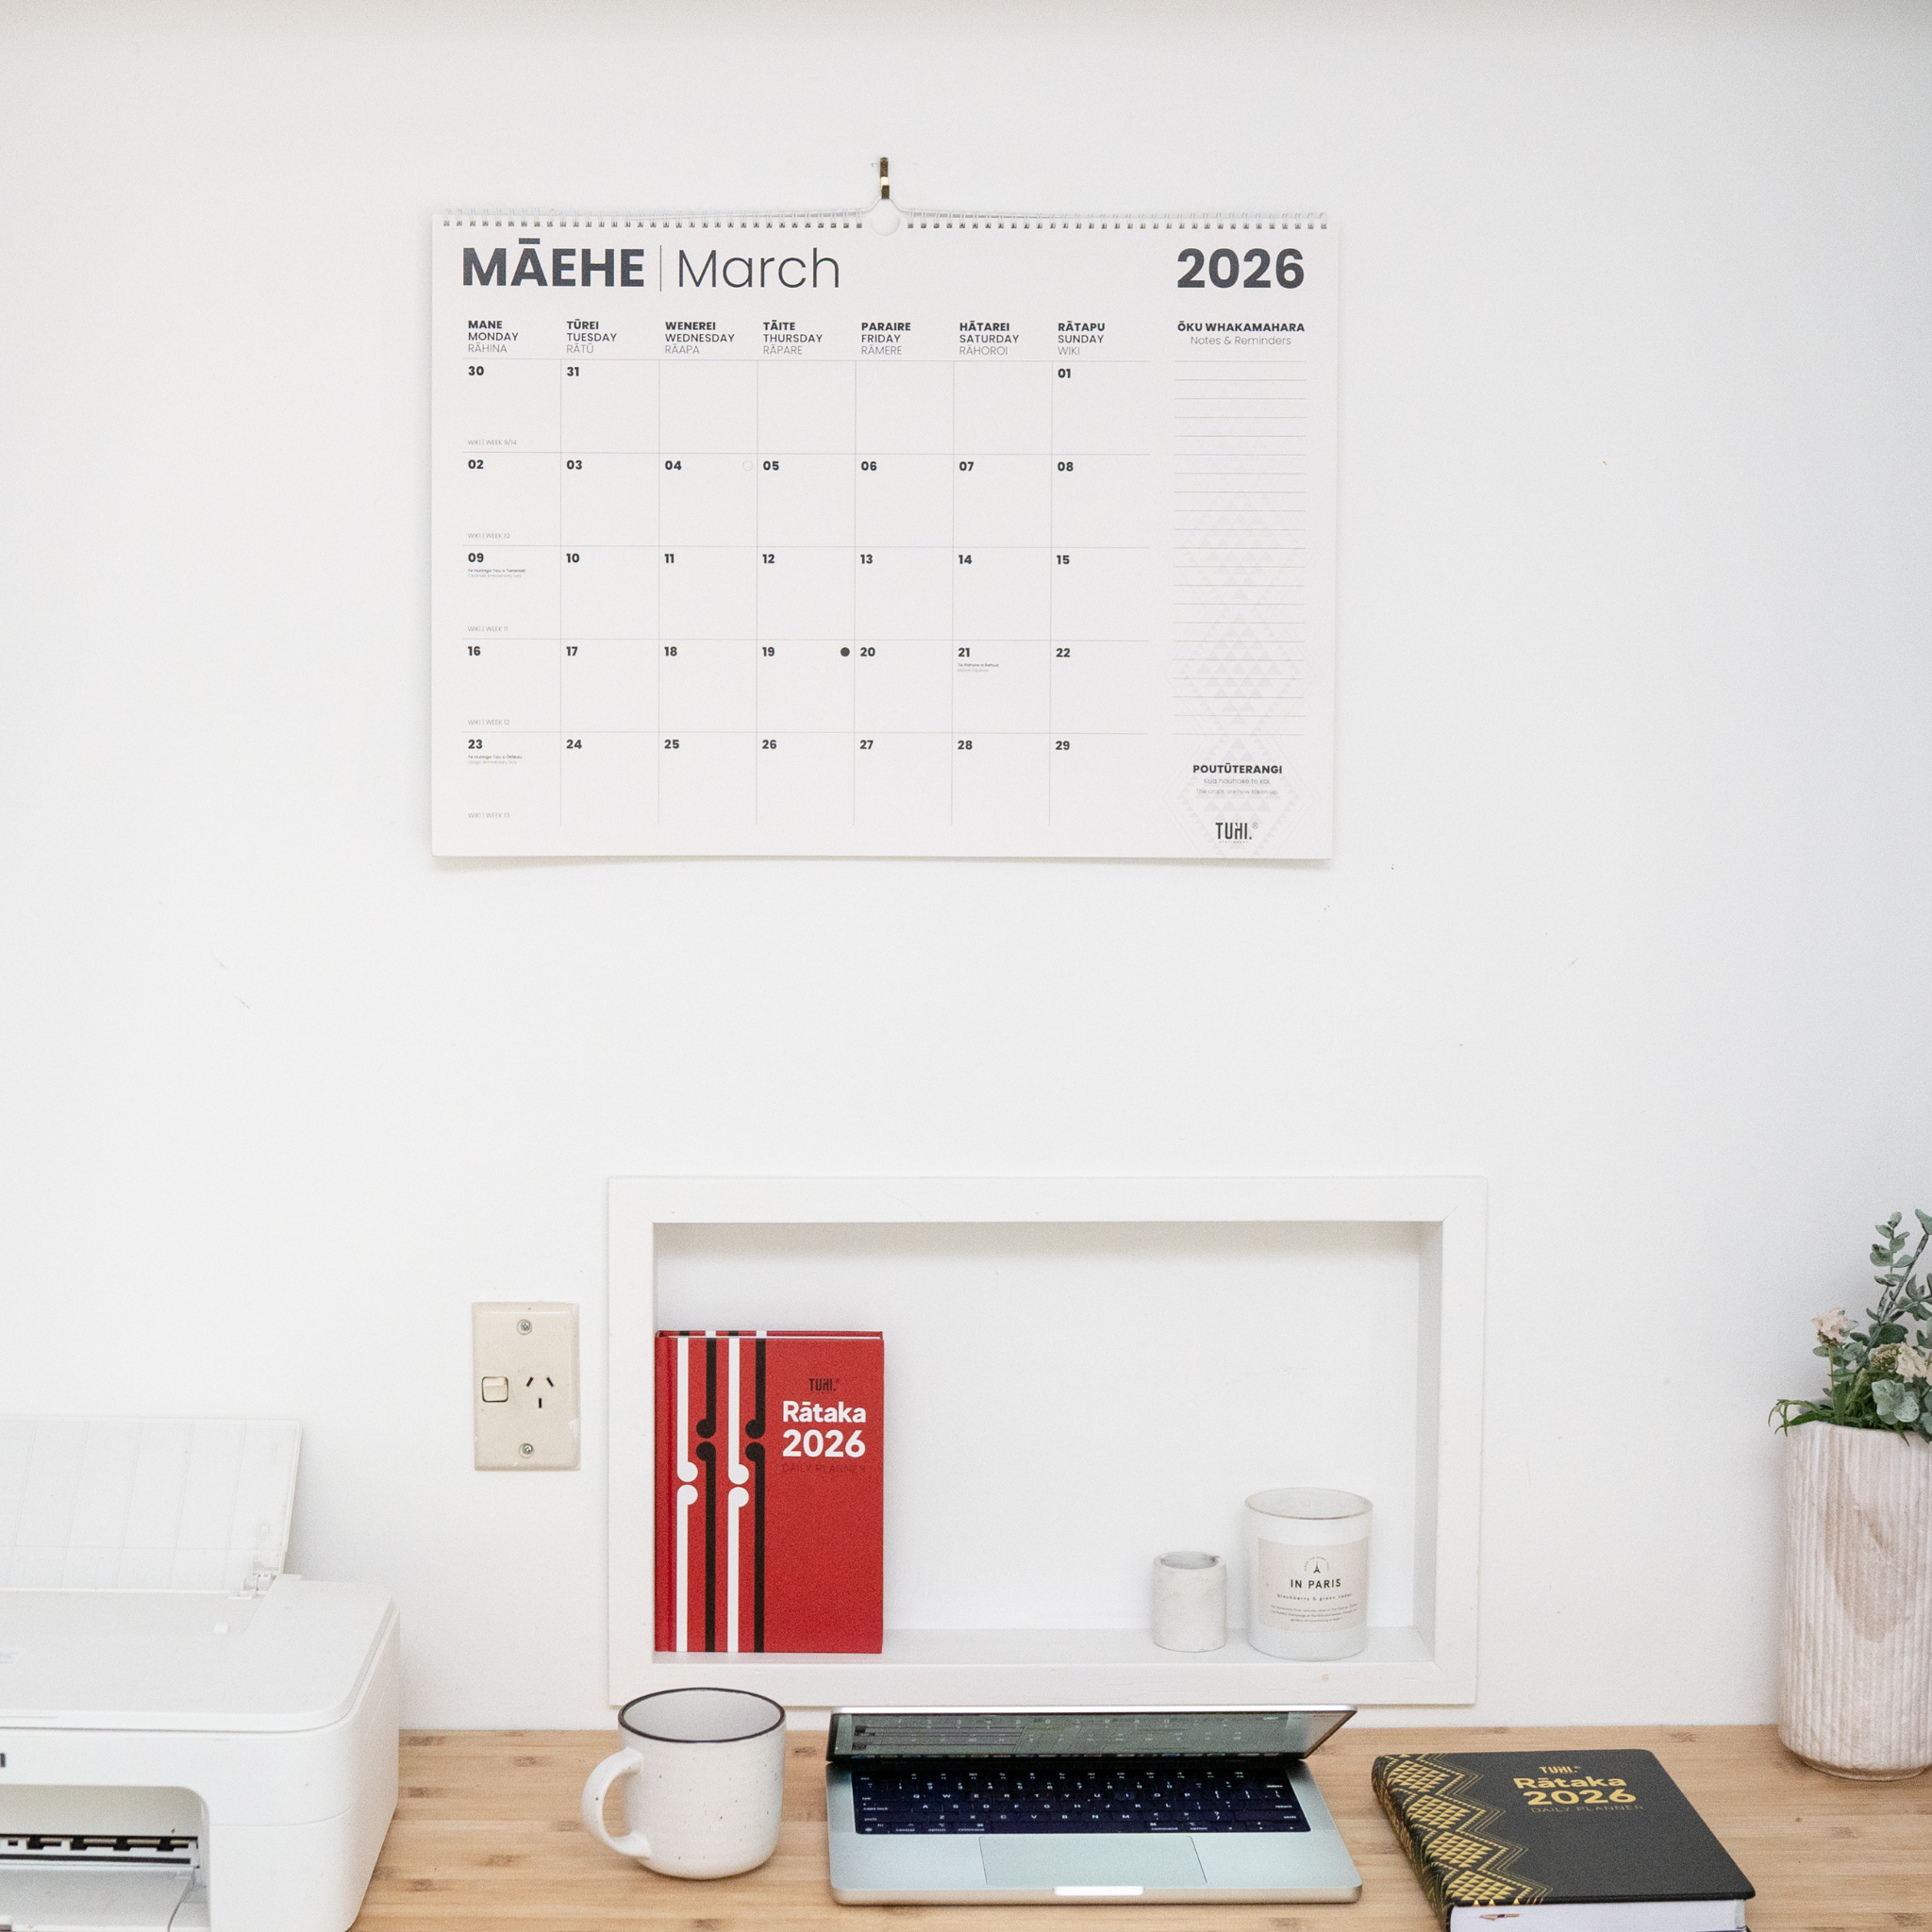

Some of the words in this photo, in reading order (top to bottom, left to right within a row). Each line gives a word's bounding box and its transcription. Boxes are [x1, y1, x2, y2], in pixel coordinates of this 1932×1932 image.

[463, 238, 644, 287] MĀEHE
[679, 247, 839, 288] March
[1177, 248, 1304, 289] 2026
[567, 319, 598, 329] TŪREI
[665, 322, 715, 330] WENEREI
[763, 320, 795, 330] TĀITE
[960, 321, 1009, 331] HĀTAREI
[1058, 321, 1105, 331] RĀTAPU
[1177, 321, 1202, 331] ŌKU
[469, 332, 518, 341] MONDAY
[567, 333, 617, 341] TUESDAY
[764, 334, 822, 342] THURSDAY
[1058, 335, 1104, 343] SUNDAY
[1224, 336, 1231, 344] &
[1235, 336, 1291, 344] Reminders
[468, 342, 507, 353] RĀHINA
[567, 343, 593, 353] RĀTŪ
[665, 343, 699, 354] RĀAPA
[763, 344, 802, 355] RĀPARE
[861, 344, 902, 355] RĀMERE
[959, 344, 1008, 355] RĀHOROI
[469, 366, 484, 375] 30
[567, 367, 579, 376] 31
[1058, 369, 1071, 378] 01
[468, 459, 483, 469] 02
[567, 460, 582, 470] 03
[665, 460, 681, 470] 04
[763, 461, 779, 471] 05
[861, 461, 876, 471] 06
[959, 461, 974, 471] 07
[1058, 461, 1074, 472] 08
[468, 553, 484, 562] 09
[566, 554, 579, 563] 10
[664, 554, 674, 563] 11
[762, 554, 774, 563] 12
[860, 555, 873, 564] 13
[958, 555, 972, 564] 14
[1057, 555, 1070, 564] 15
[468, 646, 480, 656] 16
[566, 646, 577, 656] 17
[664, 646, 677, 657] 18
[762, 647, 774, 657] 19
[860, 647, 875, 657] 20
[958, 648, 970, 657] 21
[1057, 648, 1070, 658] 22
[468, 740, 482, 749] 23
[567, 740, 582, 749] 24
[665, 740, 679, 749] 25
[762, 740, 776, 749] 26
[860, 740, 874, 749] 27
[958, 741, 973, 750] 28
[1056, 741, 1070, 750] 29
[1193, 763, 1282, 774] POUTŪTERANGI
[782, 1401, 866, 1423] Rātaka
[782, 1429, 866, 1458] 2026
[1291, 1579, 1302, 1589] IN
[1307, 1578, 1341, 1589] PARIS
[1512, 1775, 1627, 1790] Rātaka
[1523, 1789, 1637, 1806] 2026
